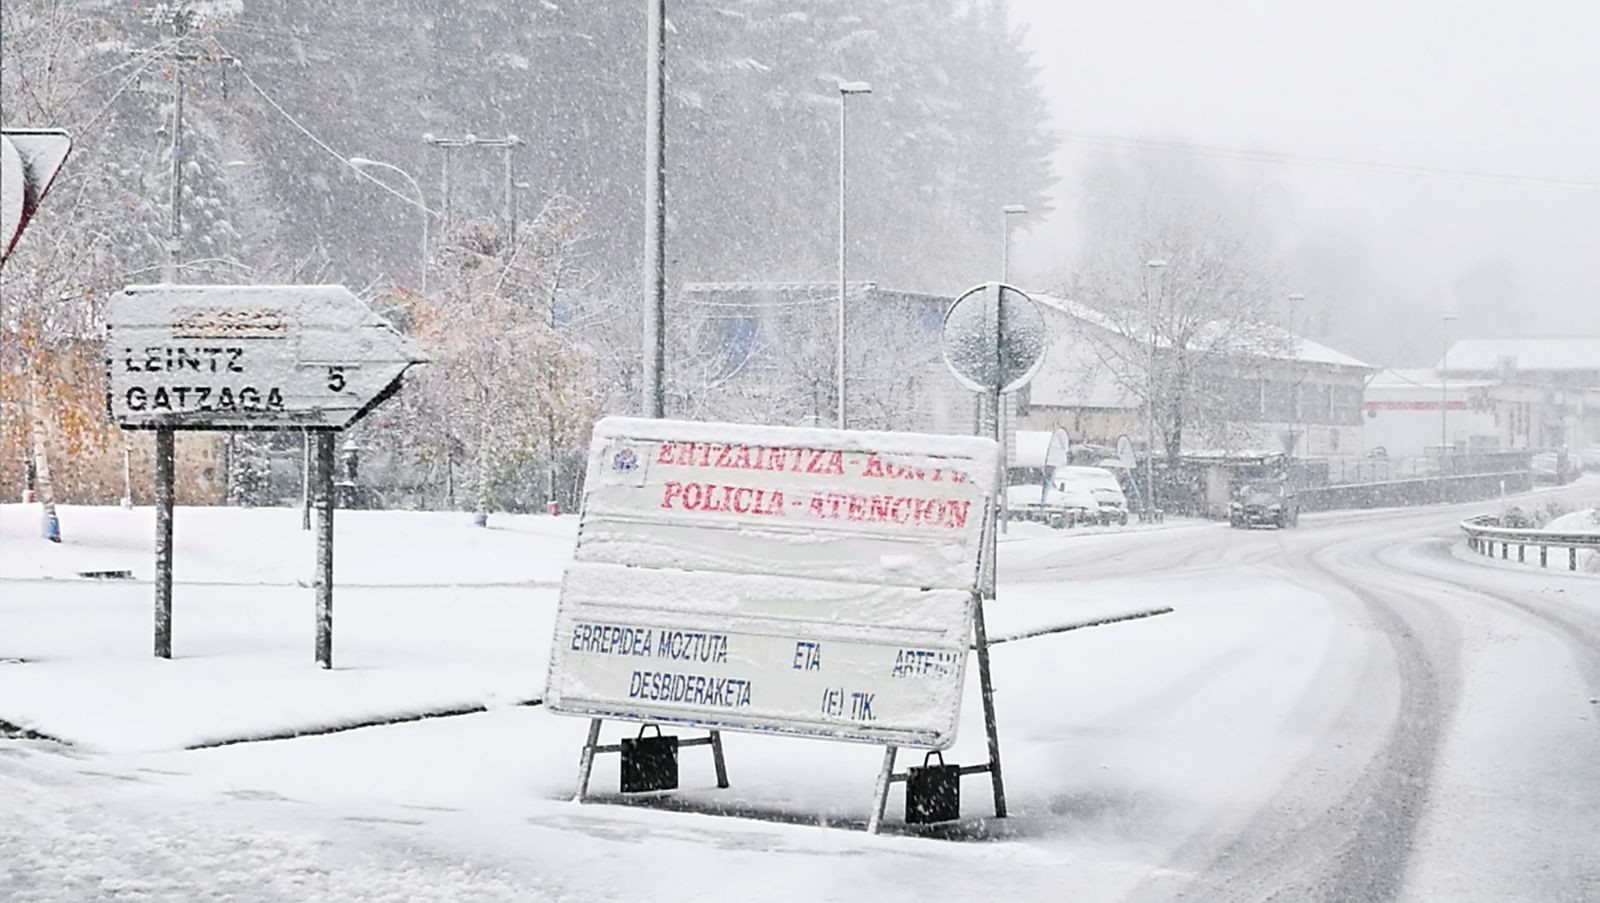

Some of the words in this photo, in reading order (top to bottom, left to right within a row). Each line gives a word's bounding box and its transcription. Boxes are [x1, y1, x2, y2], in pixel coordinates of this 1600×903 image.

[125, 347, 244, 372] LEINTZ
[328, 367, 347, 392] 5
[126, 387, 284, 412] GATZAGA
[660, 481, 786, 516] POLICIA
[571, 624, 652, 657] ERREPIDEA
[658, 630, 728, 663] MOZTUTA
[793, 641, 821, 671] ETA
[629, 671, 752, 708] DESBIDERAKETA
